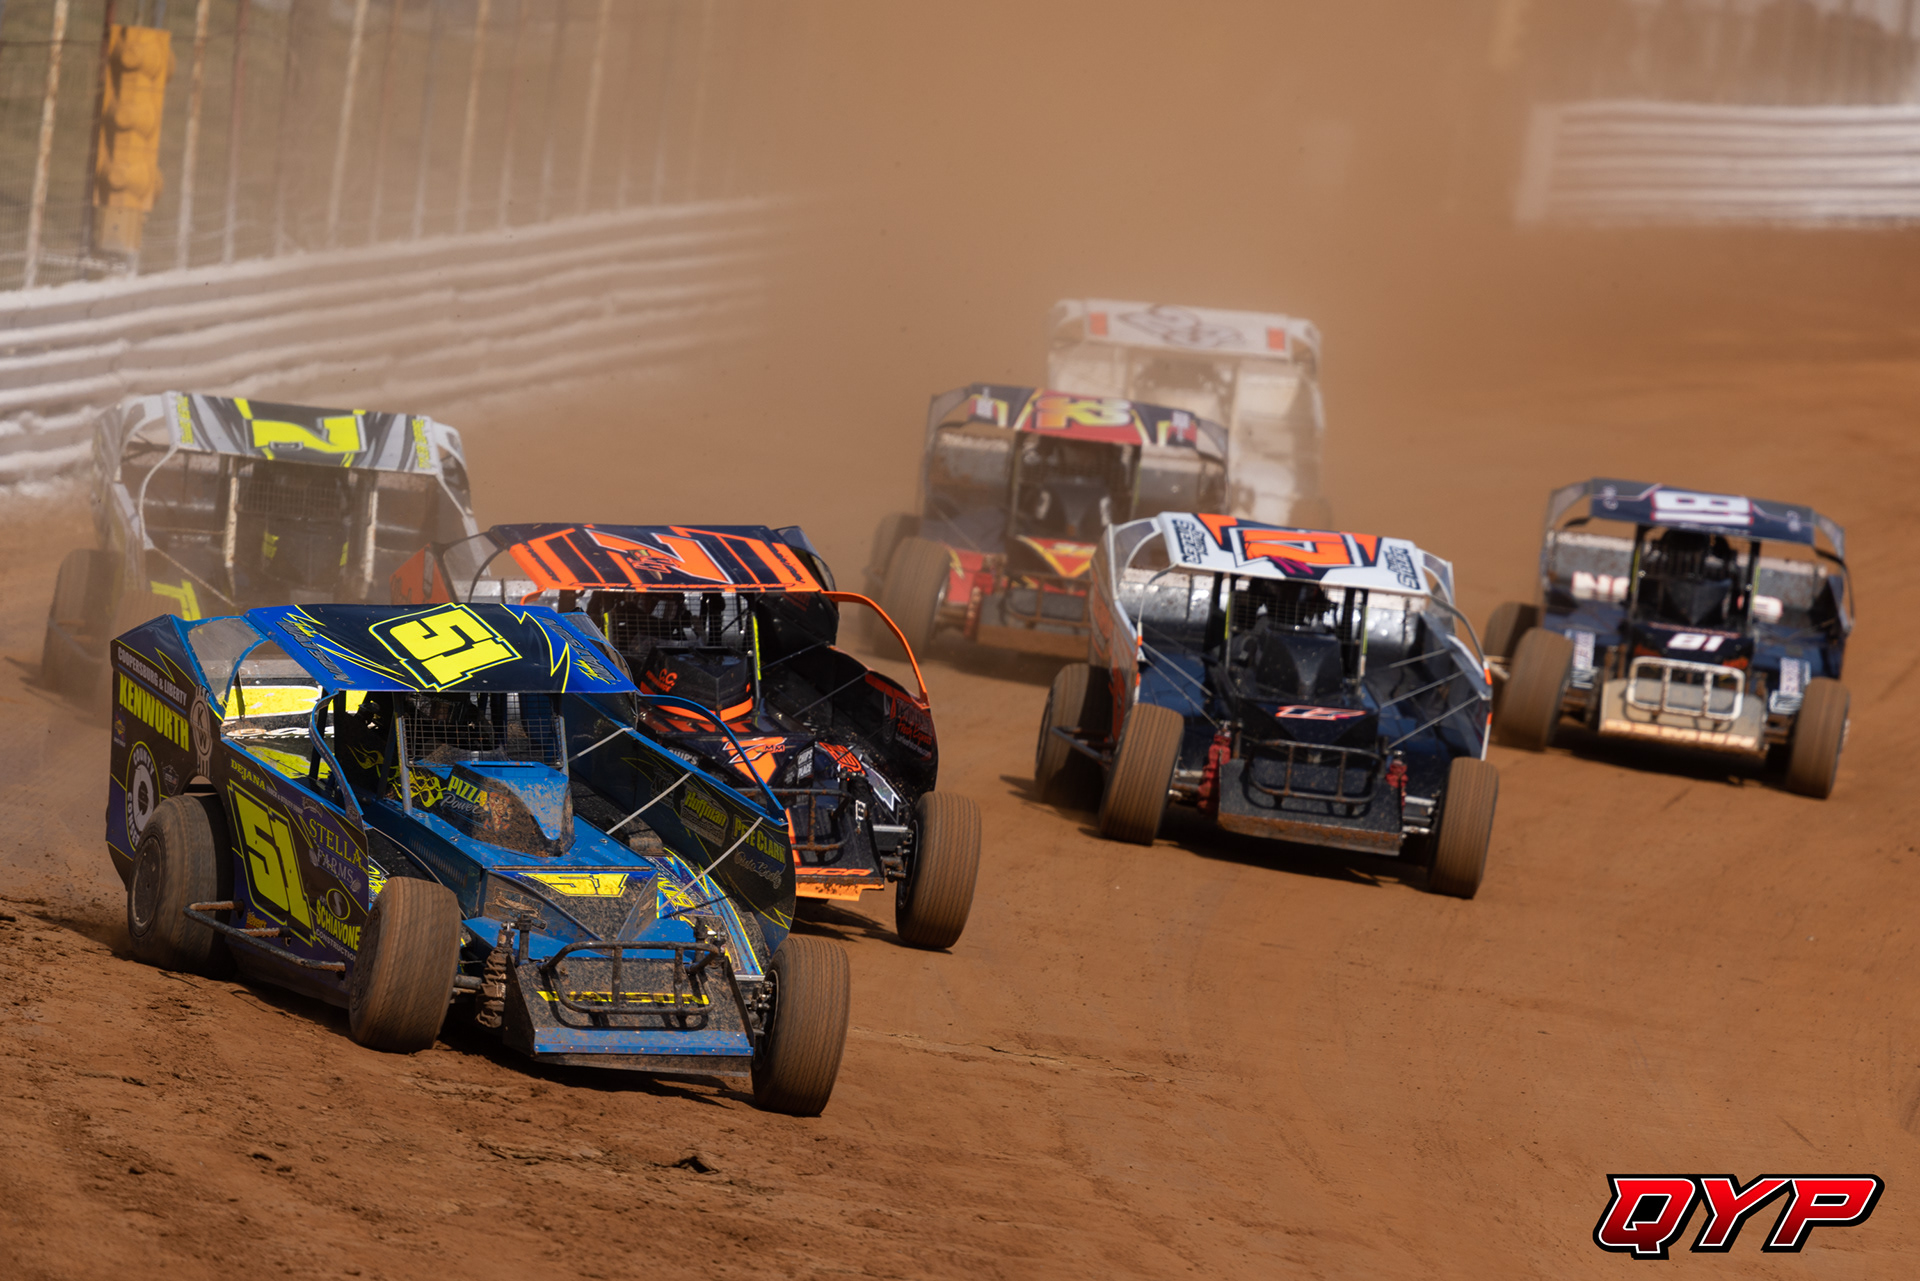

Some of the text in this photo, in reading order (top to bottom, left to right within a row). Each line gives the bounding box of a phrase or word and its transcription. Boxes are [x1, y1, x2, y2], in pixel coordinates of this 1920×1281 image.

[251, 418, 361, 454] 7
[389, 608, 513, 685] 51
[1667, 632, 1725, 652] 81
[117, 646, 188, 707] COOPERSBURG & LIBERTY
[119, 671, 190, 752] KENWORTH
[230, 758, 266, 791] DEJANA
[447, 775, 487, 807] PIZZA
[440, 792, 485, 815] Power
[684, 790, 727, 828] Hoffman
[234, 790, 312, 931] 51
[309, 818, 364, 870] STELLA
[756, 830, 786, 864] CLARK
[317, 848, 354, 884] FARMS
[518, 872, 629, 897] 51
[316, 898, 361, 951] SCHIAVONE
